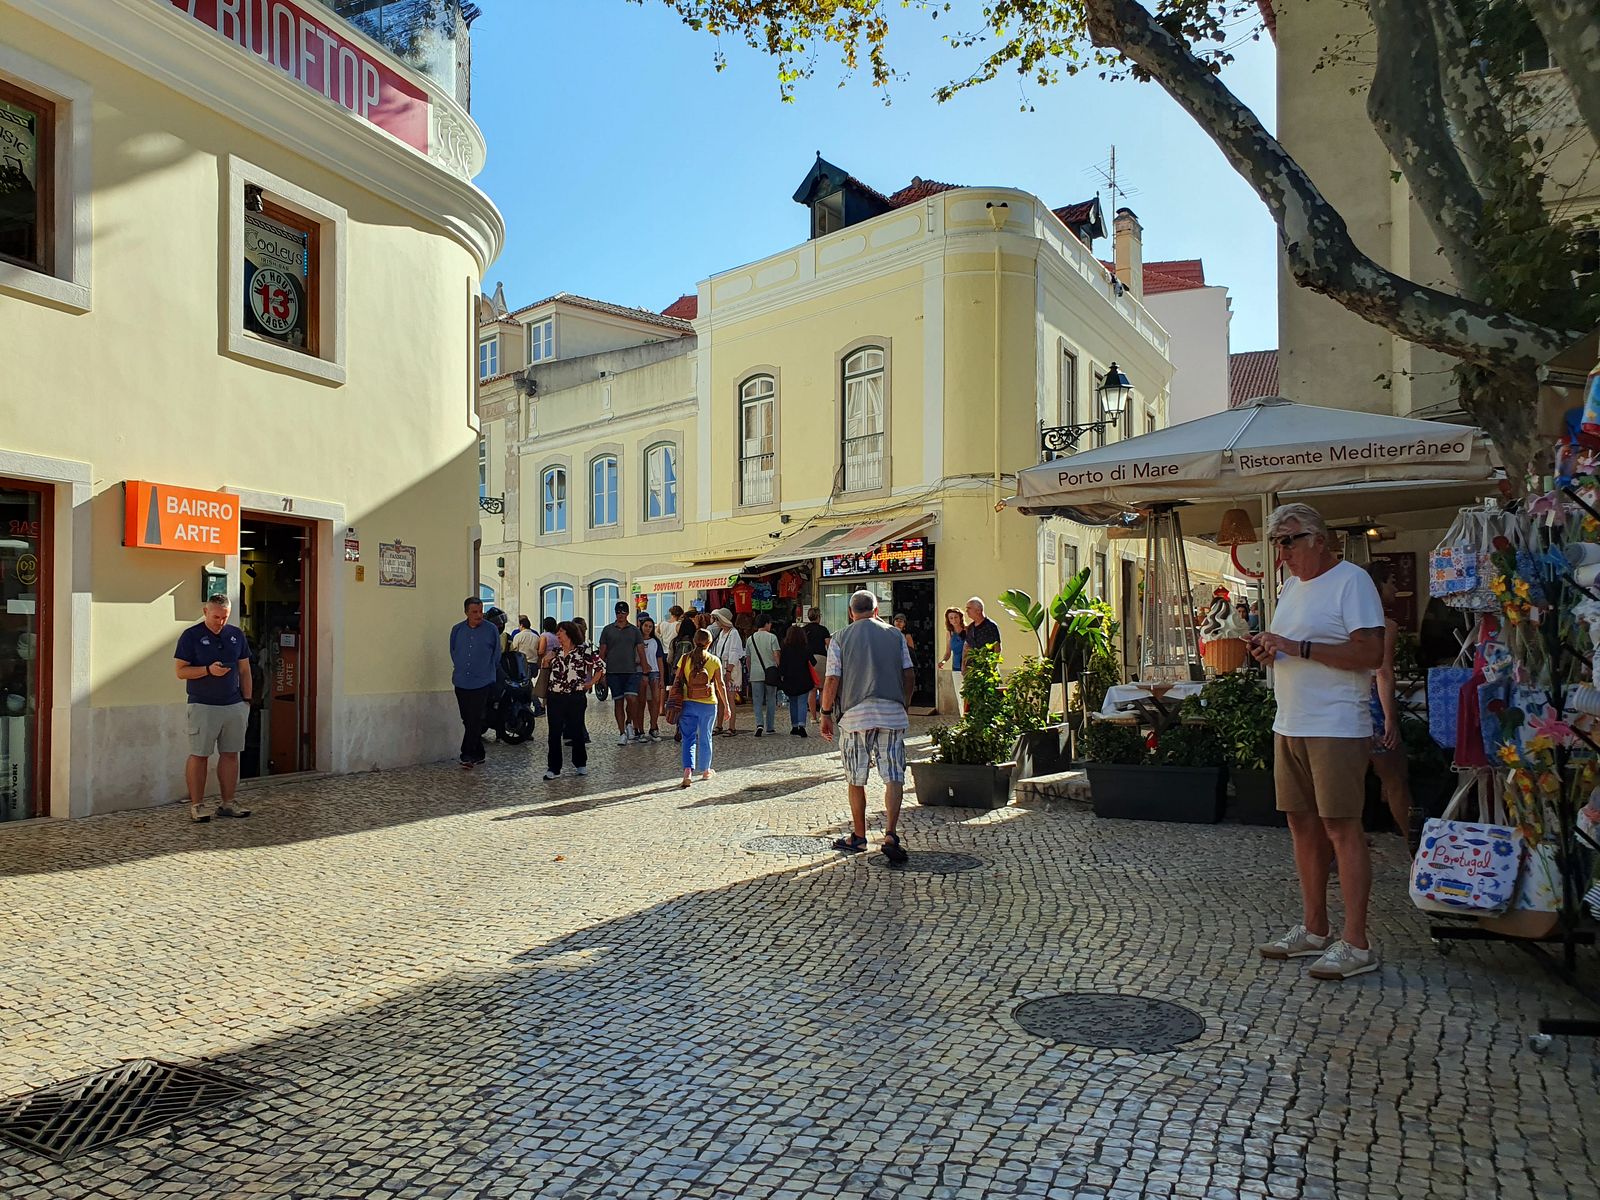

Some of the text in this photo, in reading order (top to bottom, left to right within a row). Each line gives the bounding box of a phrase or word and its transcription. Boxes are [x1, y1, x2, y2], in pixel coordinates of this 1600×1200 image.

[216, 0, 379, 119] ROOFTOP
[253, 271, 295, 304] HOP HOUSE
[257, 283, 290, 320] 13
[261, 311, 289, 329] LAGER
[1239, 440, 1465, 470] Ristorante Mediterrâneo
[1058, 462, 1179, 487] Porto di Mare
[166, 495, 233, 521] BAIRRO
[281, 497, 294, 512] 71
[174, 523, 221, 544] ARTE
[653, 577, 727, 592] SOUVENIRS PORTUGUESES
[739, 592, 746, 605] 7
[286, 663, 294, 687] ARTE
